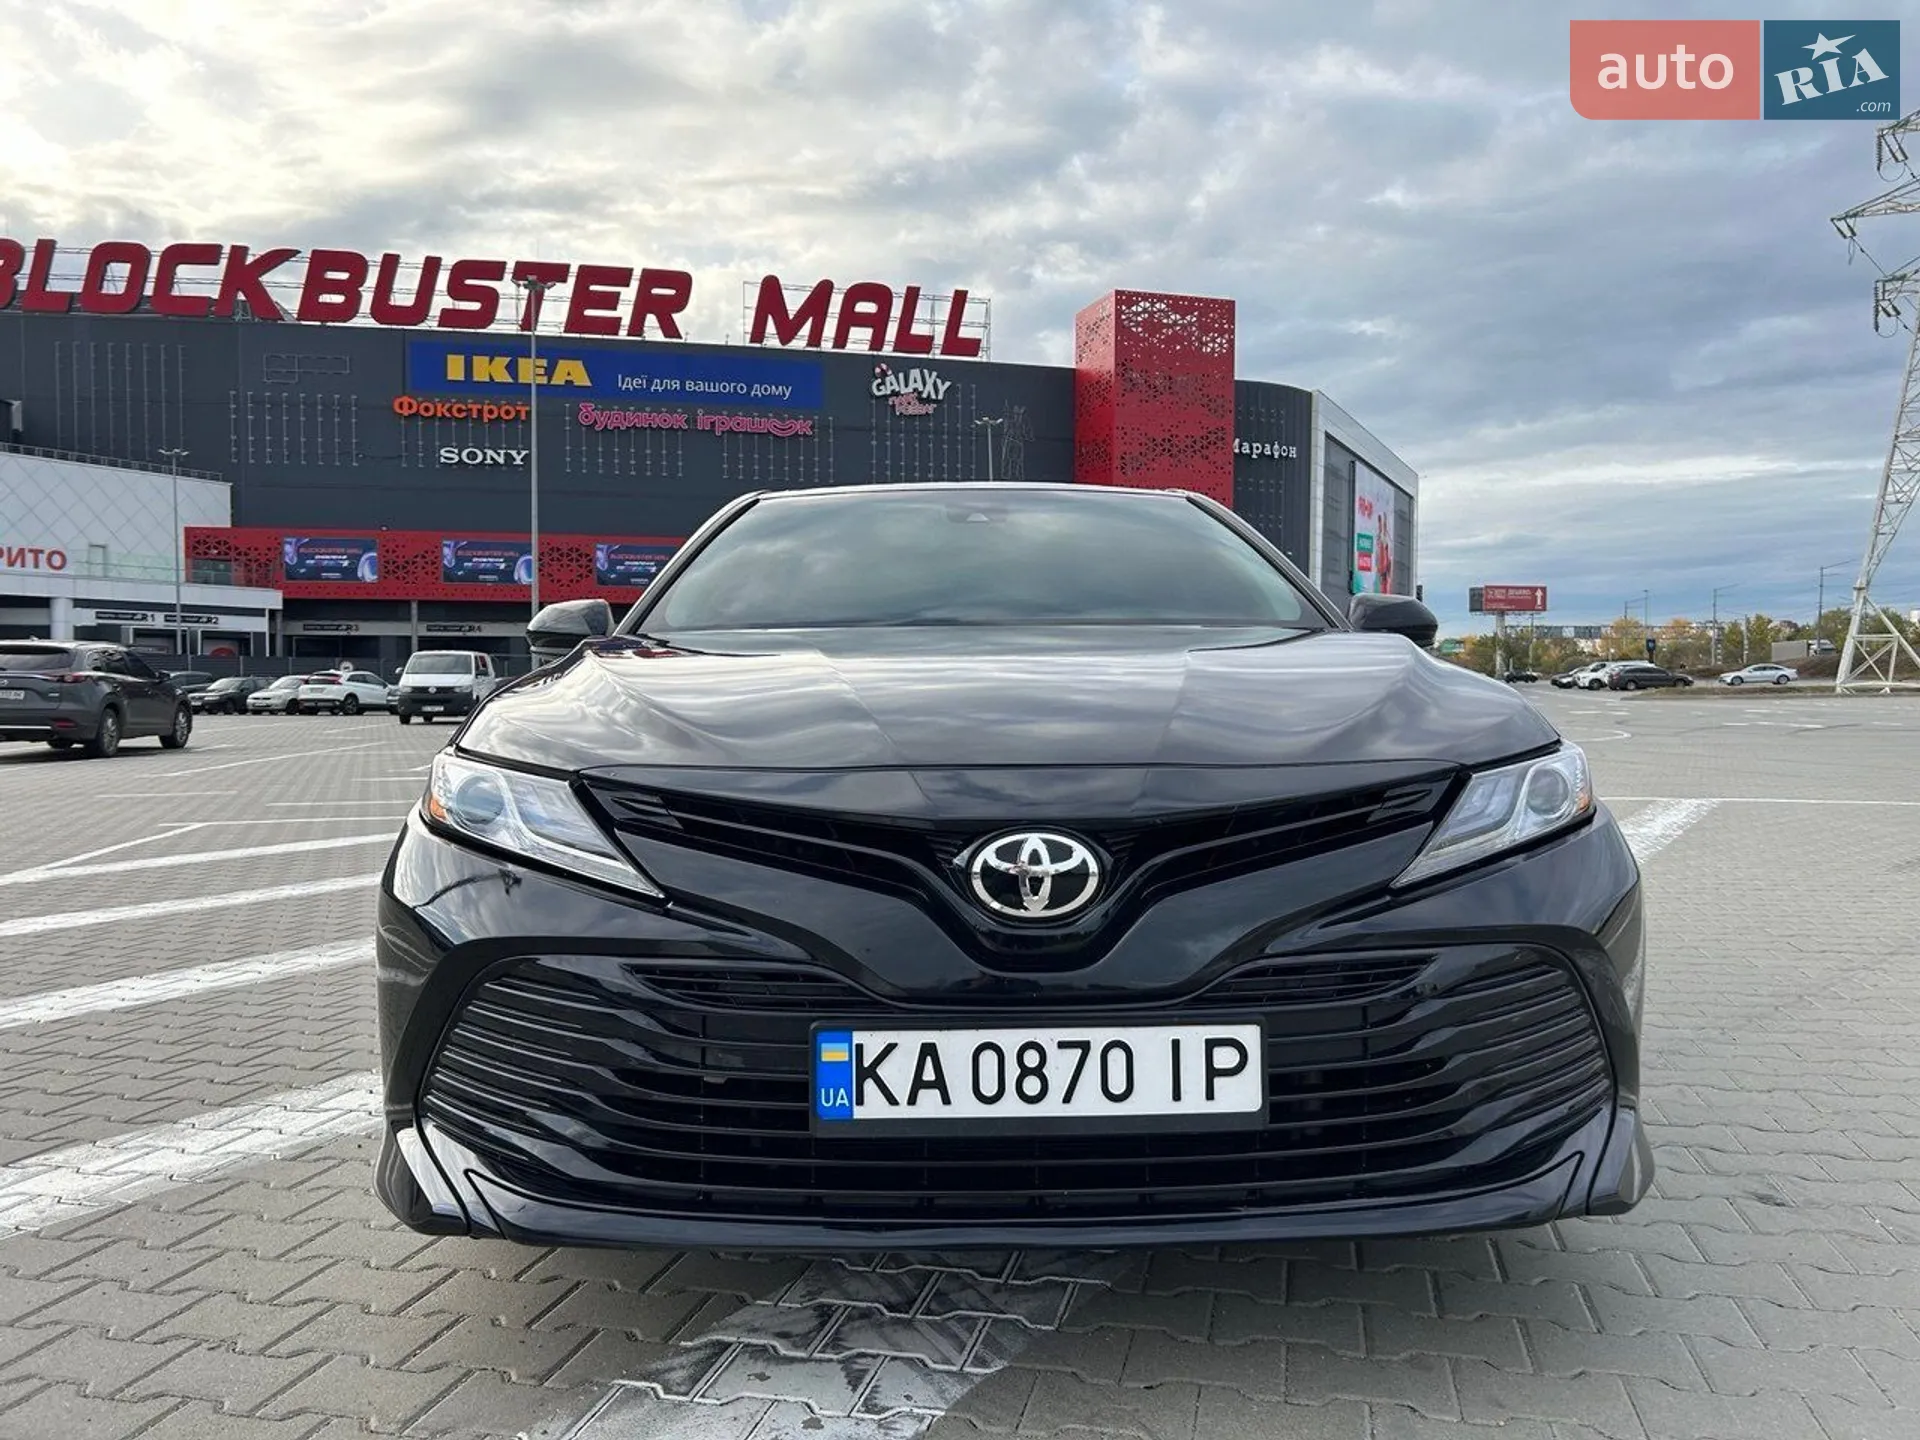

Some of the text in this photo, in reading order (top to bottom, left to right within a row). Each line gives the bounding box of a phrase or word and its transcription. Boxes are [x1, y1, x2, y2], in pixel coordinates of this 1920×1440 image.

[750, 274, 982, 357] MALL
[447, 354, 592, 386] IKEA
[618, 374, 792, 399] Ідеї для вашого дому
[871, 367, 952, 400] GALAXY
[393, 396, 530, 422] Фокстрот
[578, 402, 688, 429] будинок
[440, 448, 529, 465] SONY
[0, 546, 67, 571] ИТО
[855, 1038, 1249, 1106] KA 0870 IP
[821, 1088, 849, 1108] UA
